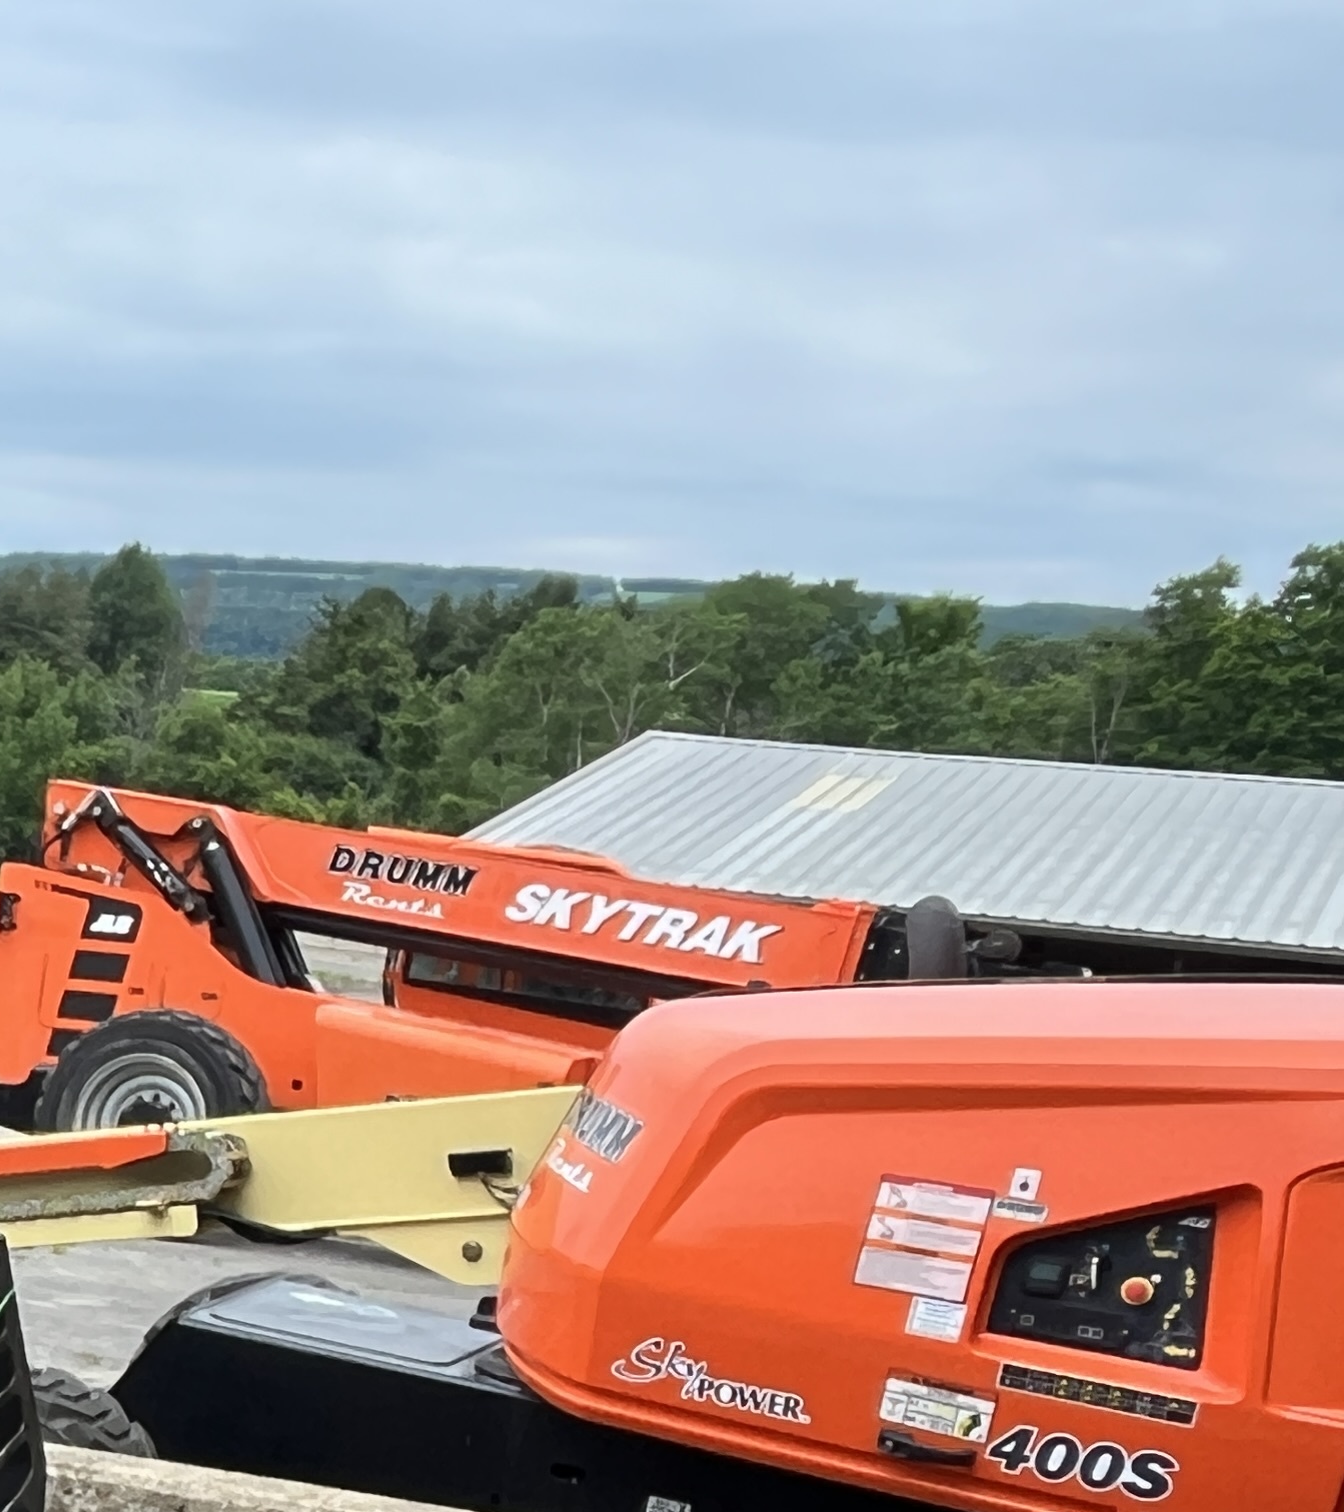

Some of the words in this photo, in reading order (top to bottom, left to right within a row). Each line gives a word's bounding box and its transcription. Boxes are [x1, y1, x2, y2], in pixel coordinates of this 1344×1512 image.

[328, 844, 480, 897] DRUMM
[340, 880, 445, 920] Rents
[505, 883, 783, 964] SKYTRAK
[984, 1424, 1180, 1502] 400S
